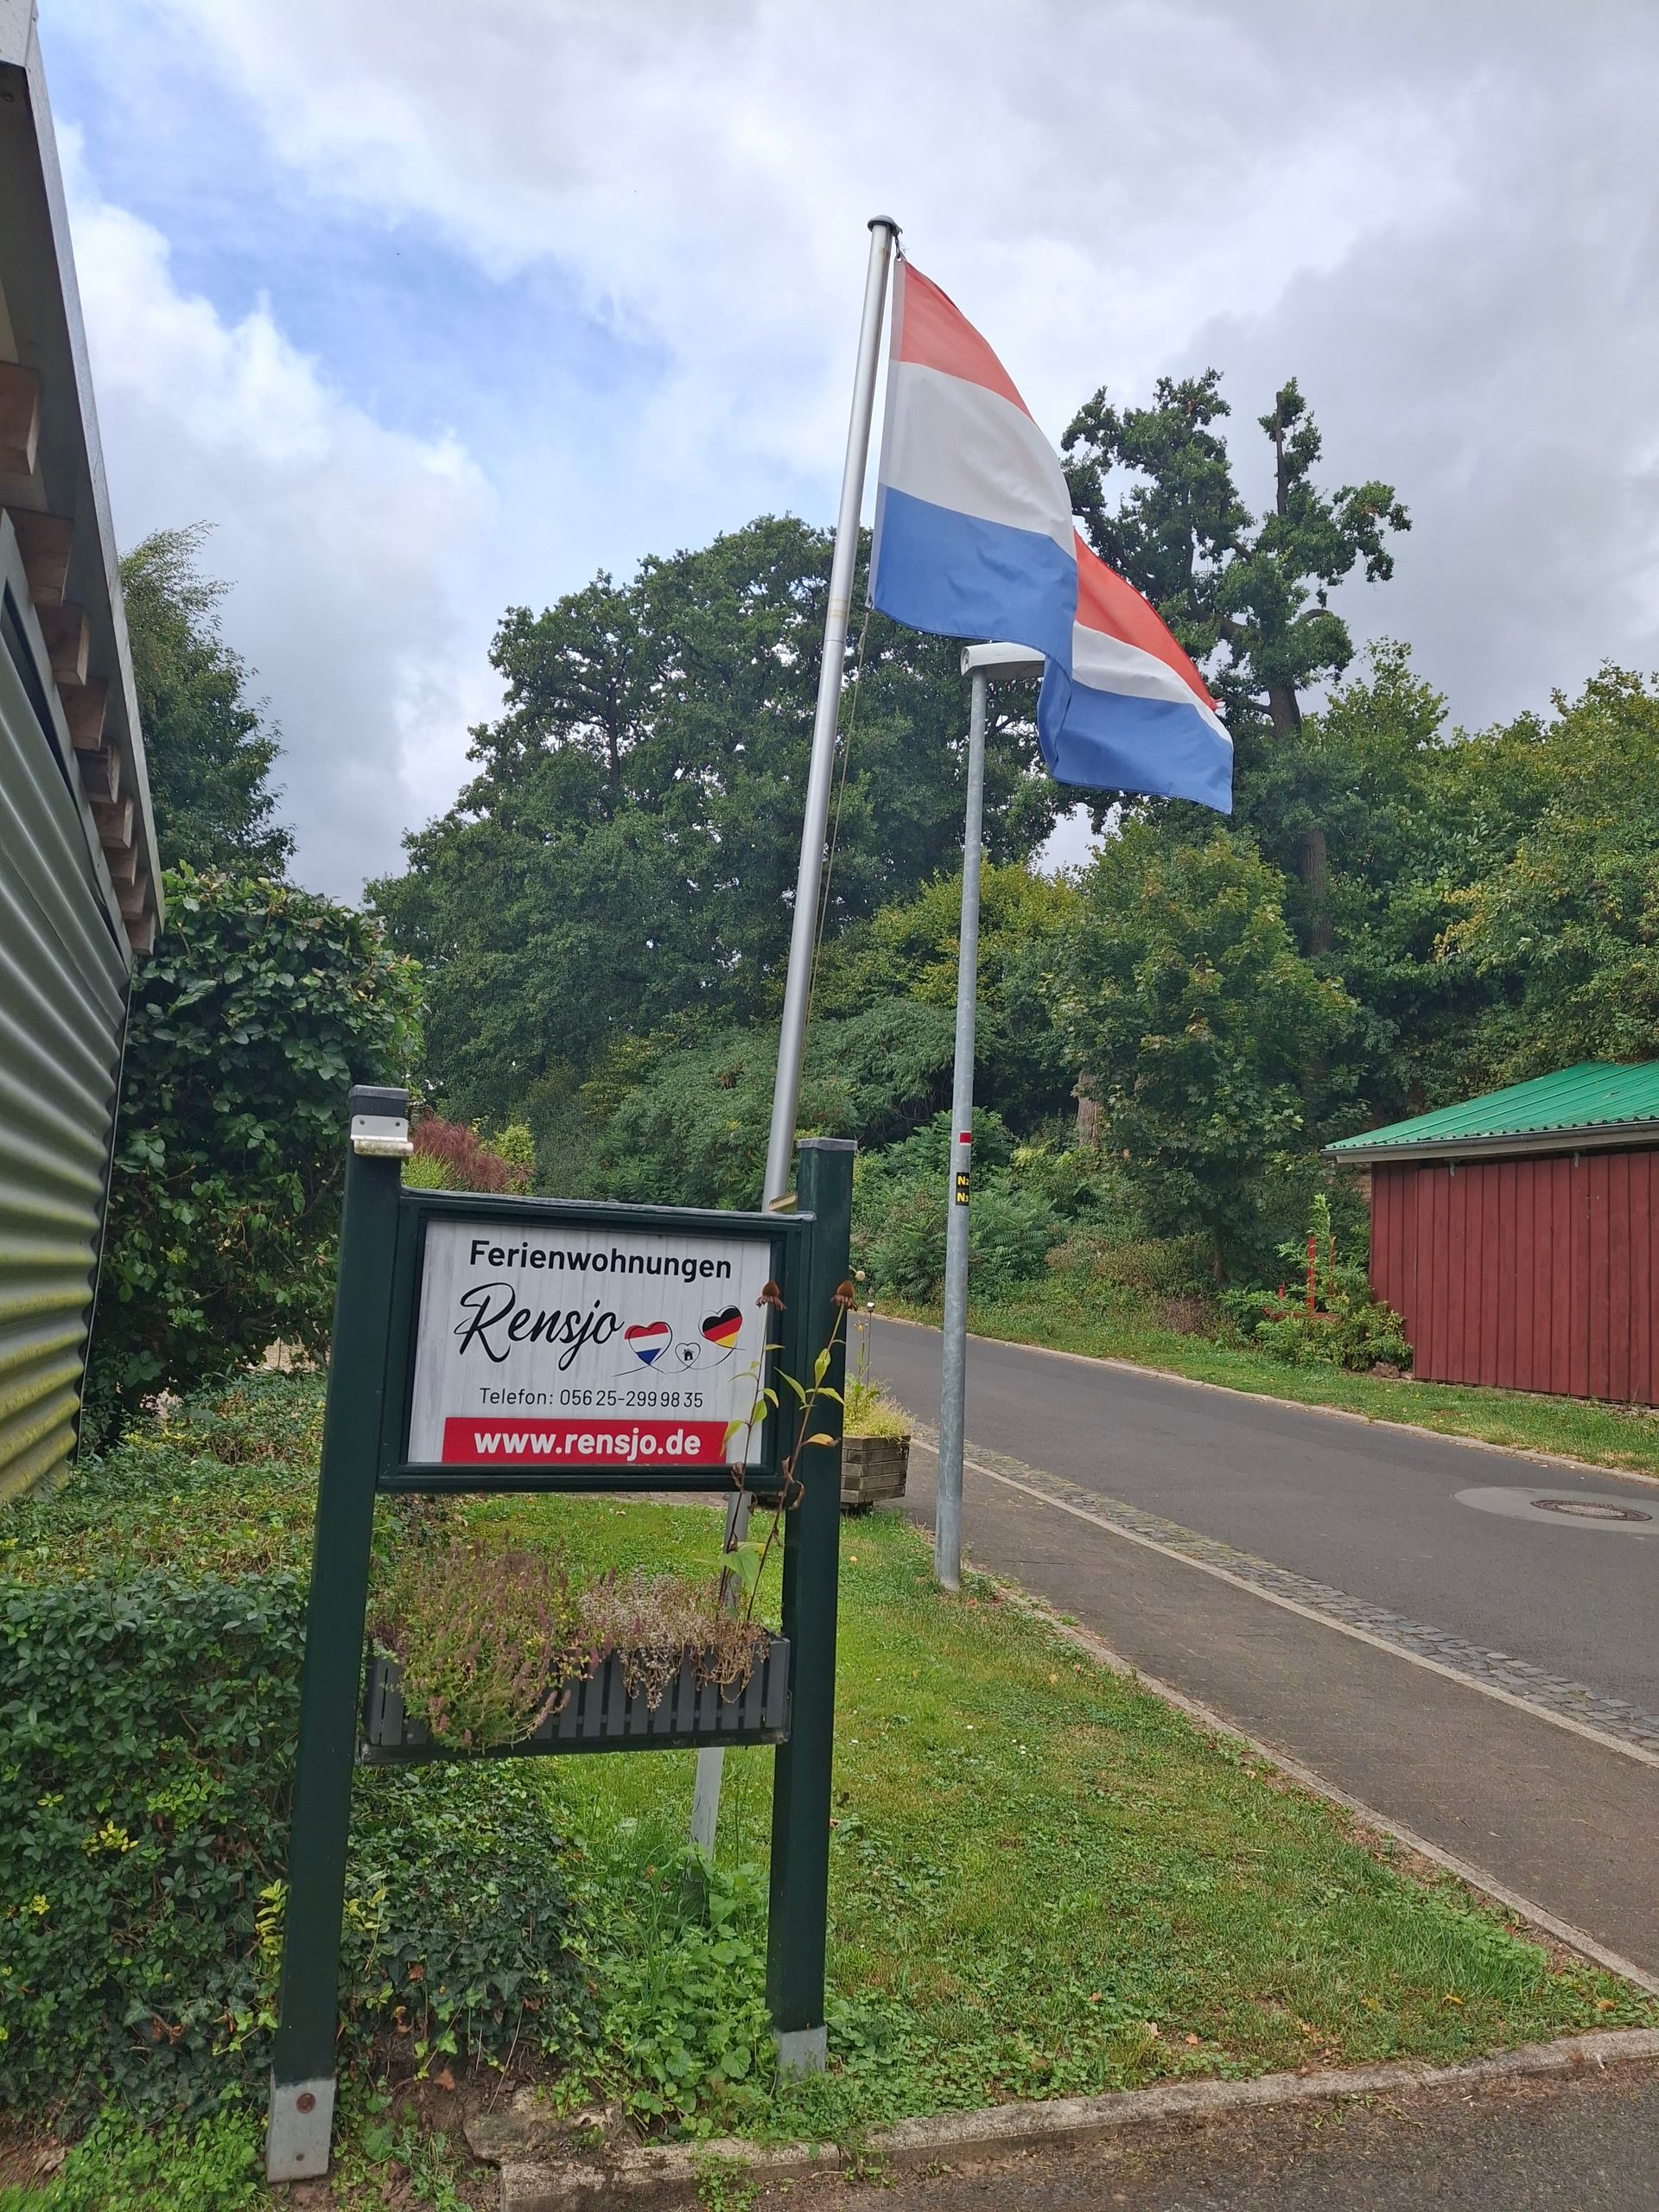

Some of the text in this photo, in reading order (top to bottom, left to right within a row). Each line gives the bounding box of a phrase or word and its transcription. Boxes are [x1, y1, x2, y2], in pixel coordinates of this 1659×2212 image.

[957, 1176, 969, 1185] N2
[470, 1240, 731, 1282] Ferienwohnungen
[454, 1282, 624, 1370] Rensjo
[480, 1388, 553, 1405] Telefon:
[474, 1427, 701, 1461] www.rensjo.de
